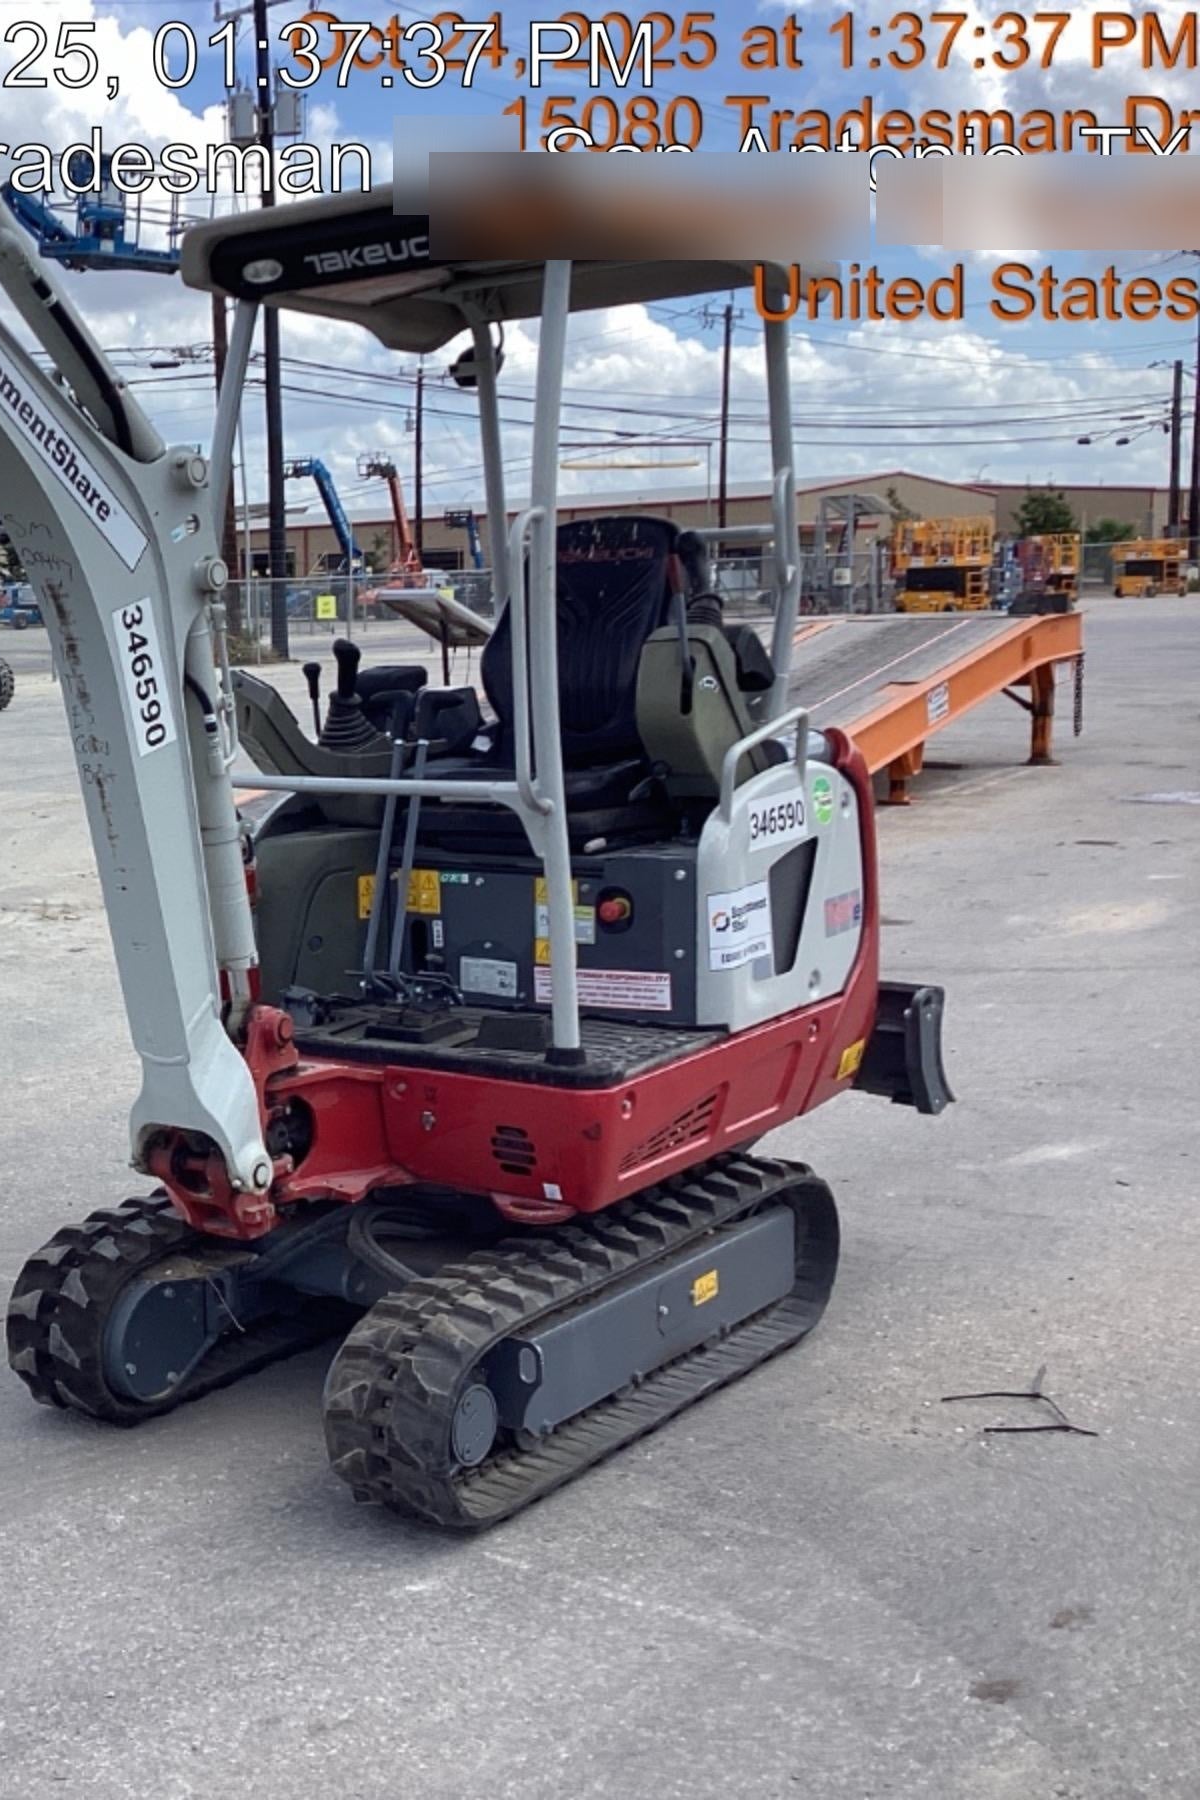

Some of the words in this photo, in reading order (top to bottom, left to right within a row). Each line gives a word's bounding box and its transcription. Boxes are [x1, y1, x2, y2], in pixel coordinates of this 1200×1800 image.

[304, 236, 430, 275] TAKEUC
[121, 605, 167, 747] 346590
[751, 800, 805, 840] 346590
